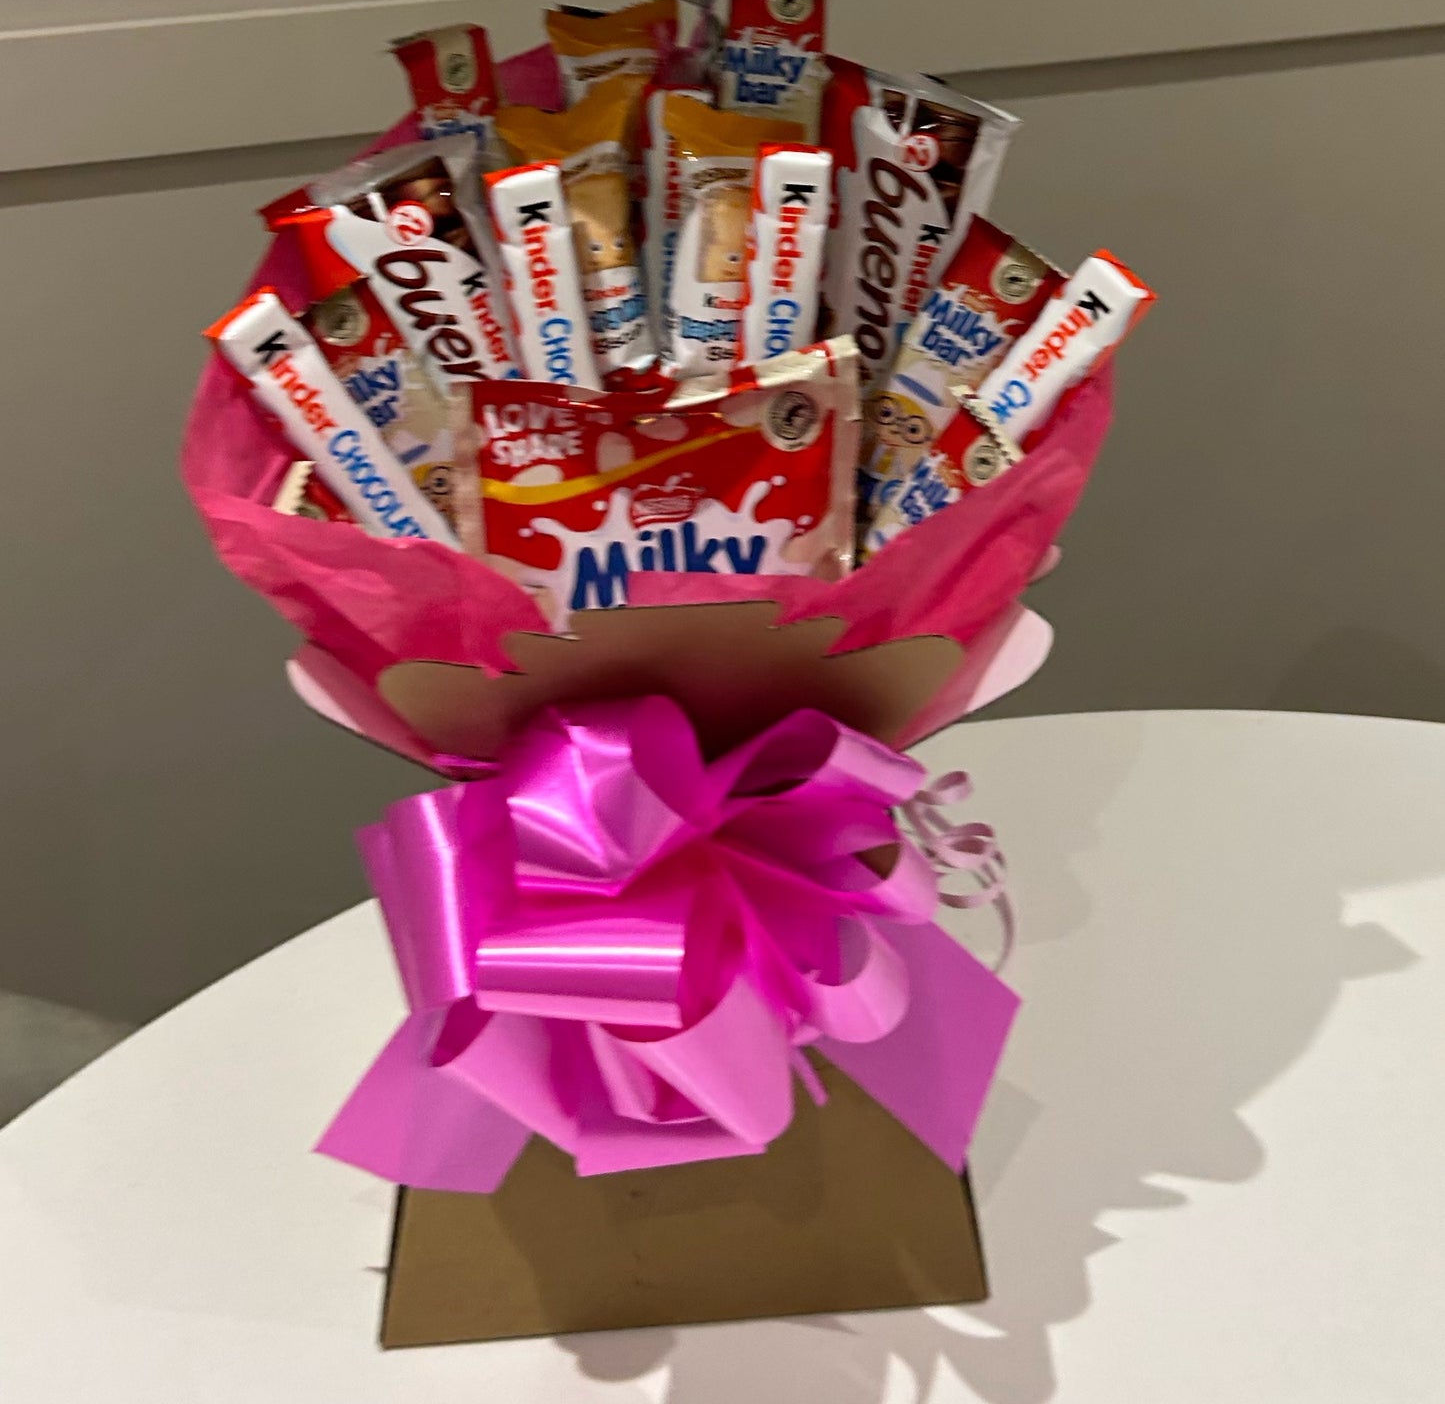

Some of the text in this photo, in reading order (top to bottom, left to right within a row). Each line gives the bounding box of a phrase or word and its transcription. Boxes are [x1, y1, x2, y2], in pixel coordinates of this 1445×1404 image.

[855, 157, 929, 360] bueno
[920, 289, 1004, 358] Milky
[921, 320, 975, 366] bar
[482, 402, 578, 439] LOVE
[570, 521, 768, 611] Milky
